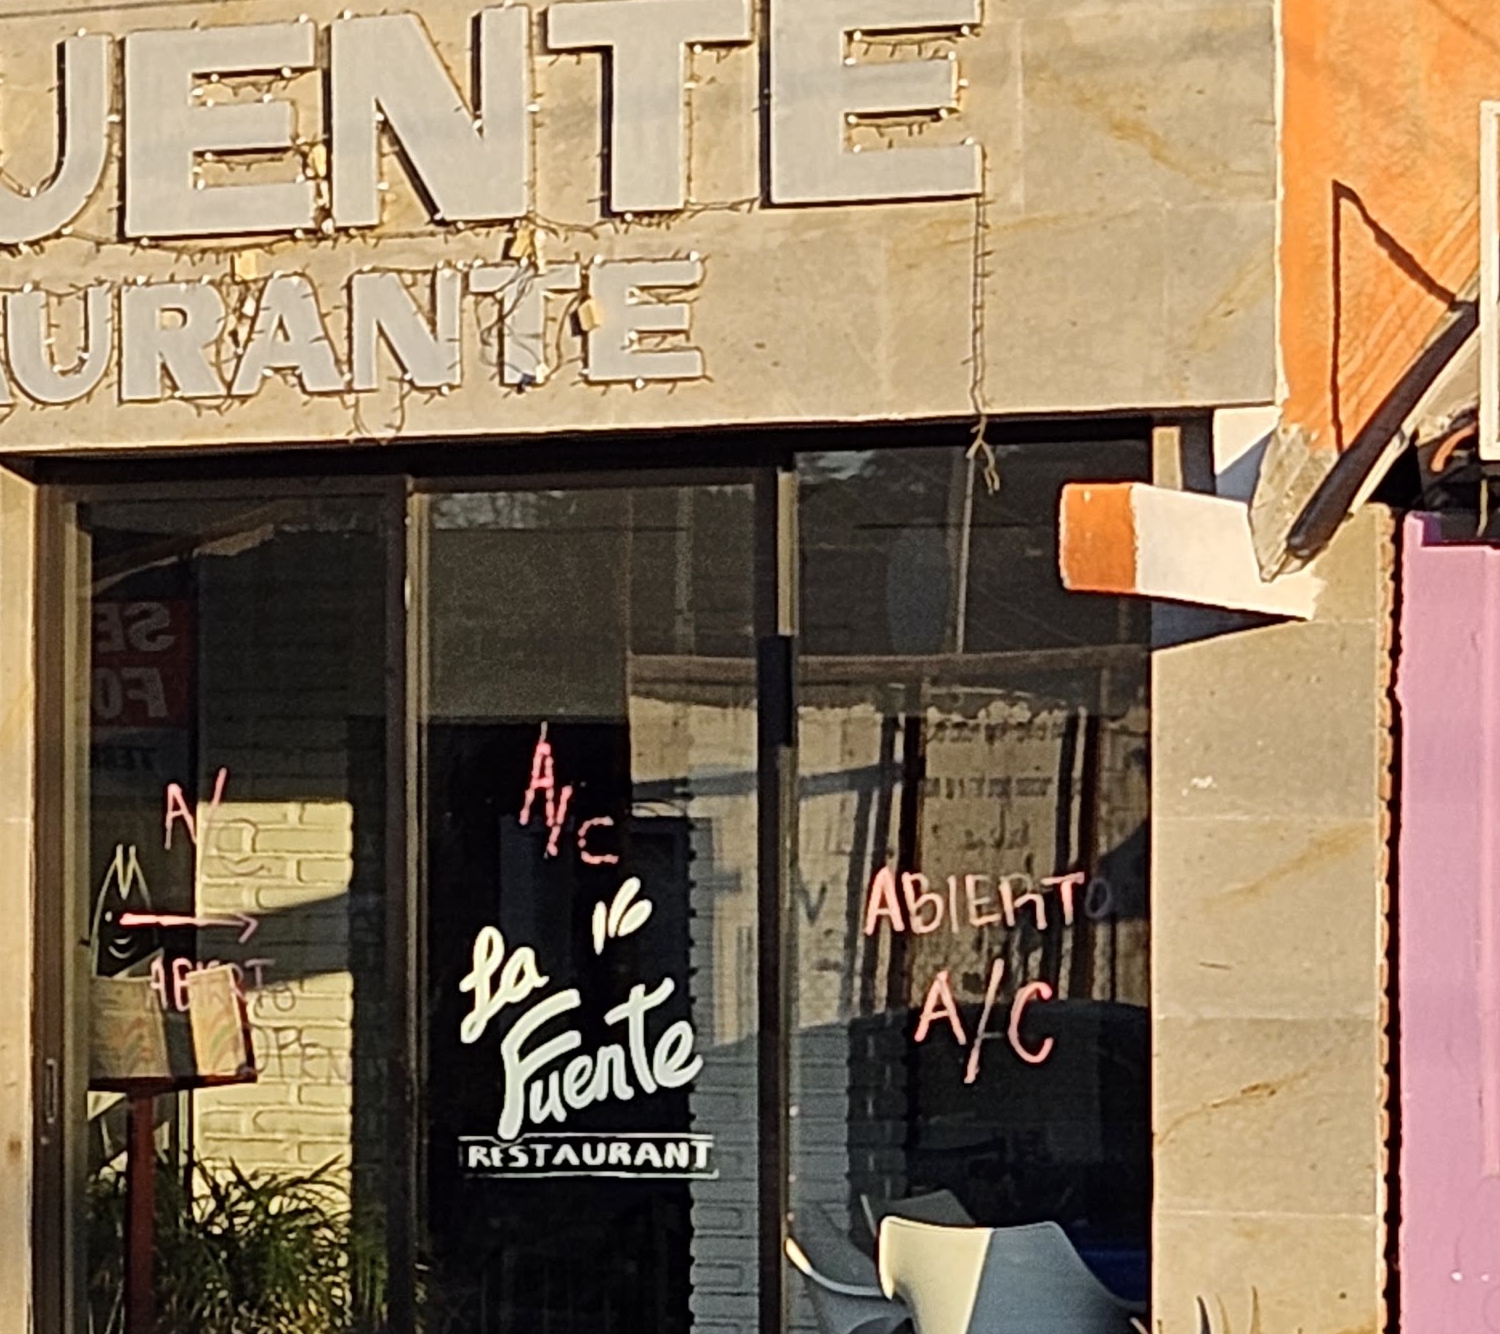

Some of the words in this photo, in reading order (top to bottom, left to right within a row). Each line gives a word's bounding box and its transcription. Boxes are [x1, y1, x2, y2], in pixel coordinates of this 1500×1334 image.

[519, 722, 619, 865] A/C
[865, 865, 1113, 937] ABIERTO
[459, 925, 550, 1045] La
[914, 957, 1055, 1085] A/C
[498, 976, 703, 1141] Fuente
[467, 1139, 714, 1169] RESTAURANT
